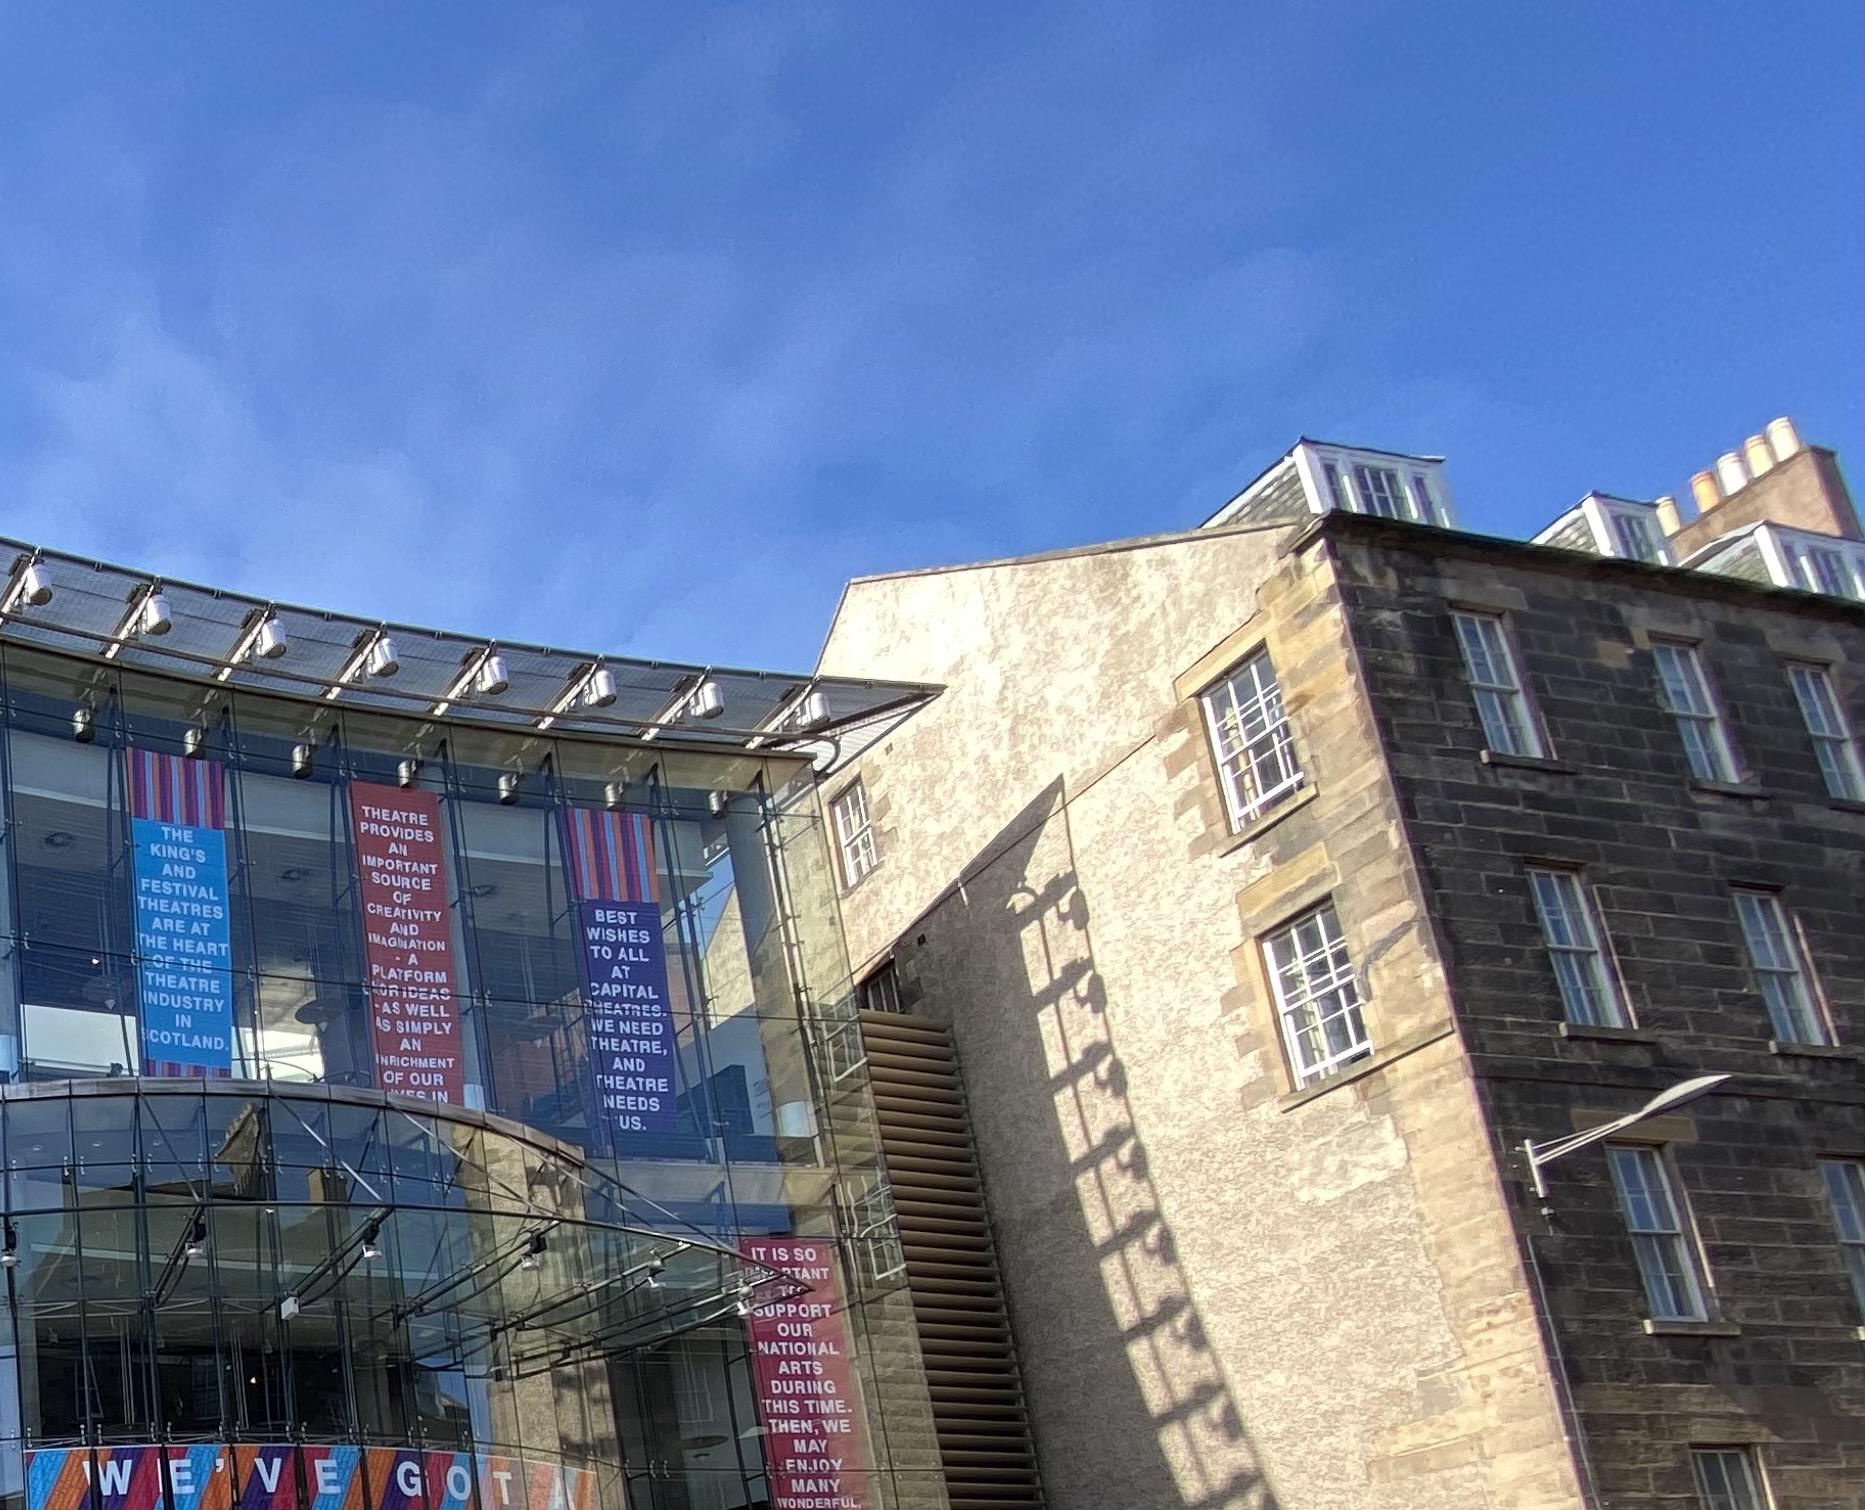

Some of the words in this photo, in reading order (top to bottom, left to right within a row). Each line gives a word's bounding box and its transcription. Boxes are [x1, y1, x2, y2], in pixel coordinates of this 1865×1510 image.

[362, 806, 428, 826] THEATRE
[161, 827, 193, 843] THE
[360, 823, 434, 842] PROVIDES
[162, 864, 196, 879] AND
[363, 855, 437, 875] IMPORTANT
[372, 872, 431, 890] SOURCE
[141, 879, 218, 900] FESTIVAL
[595, 910, 637, 925] BEST
[587, 927, 650, 944] WISHES
[591, 946, 612, 960] TO
[618, 949, 649, 962] ALL
[372, 965, 447, 983] PLATFORM
[611, 966, 630, 979] AT
[145, 972, 220, 993] THEATRE
[175, 1014, 191, 1028] IN
[613, 1058, 645, 1072] AND
[777, 1323, 812, 1337] OUR
[779, 1361, 822, 1375] ARTS
[771, 1381, 836, 1395] DURING
[794, 1440, 827, 1453] MAY
[397, 1460, 513, 1505] GOT
[792, 1479, 840, 1493] MANY
